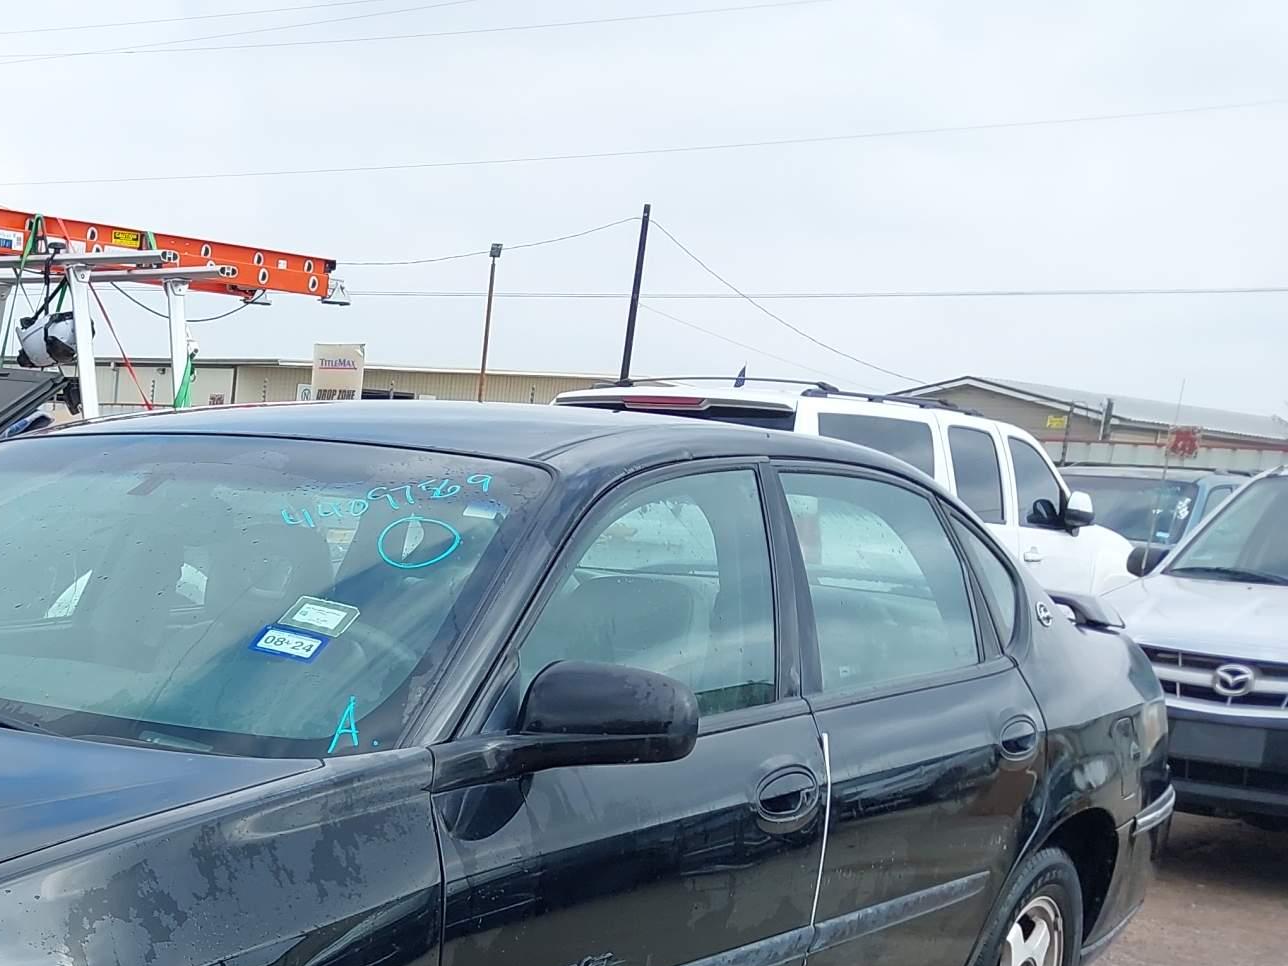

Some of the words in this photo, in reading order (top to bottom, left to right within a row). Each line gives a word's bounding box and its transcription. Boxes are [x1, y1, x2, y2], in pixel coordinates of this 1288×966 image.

[316, 389, 336, 400] DROP
[338, 390, 356, 400] ZONE
[280, 474, 492, 528] 44097569
[264, 635, 287, 647] 08
[291, 641, 314, 653] 24
[327, 696, 359, 753] A
